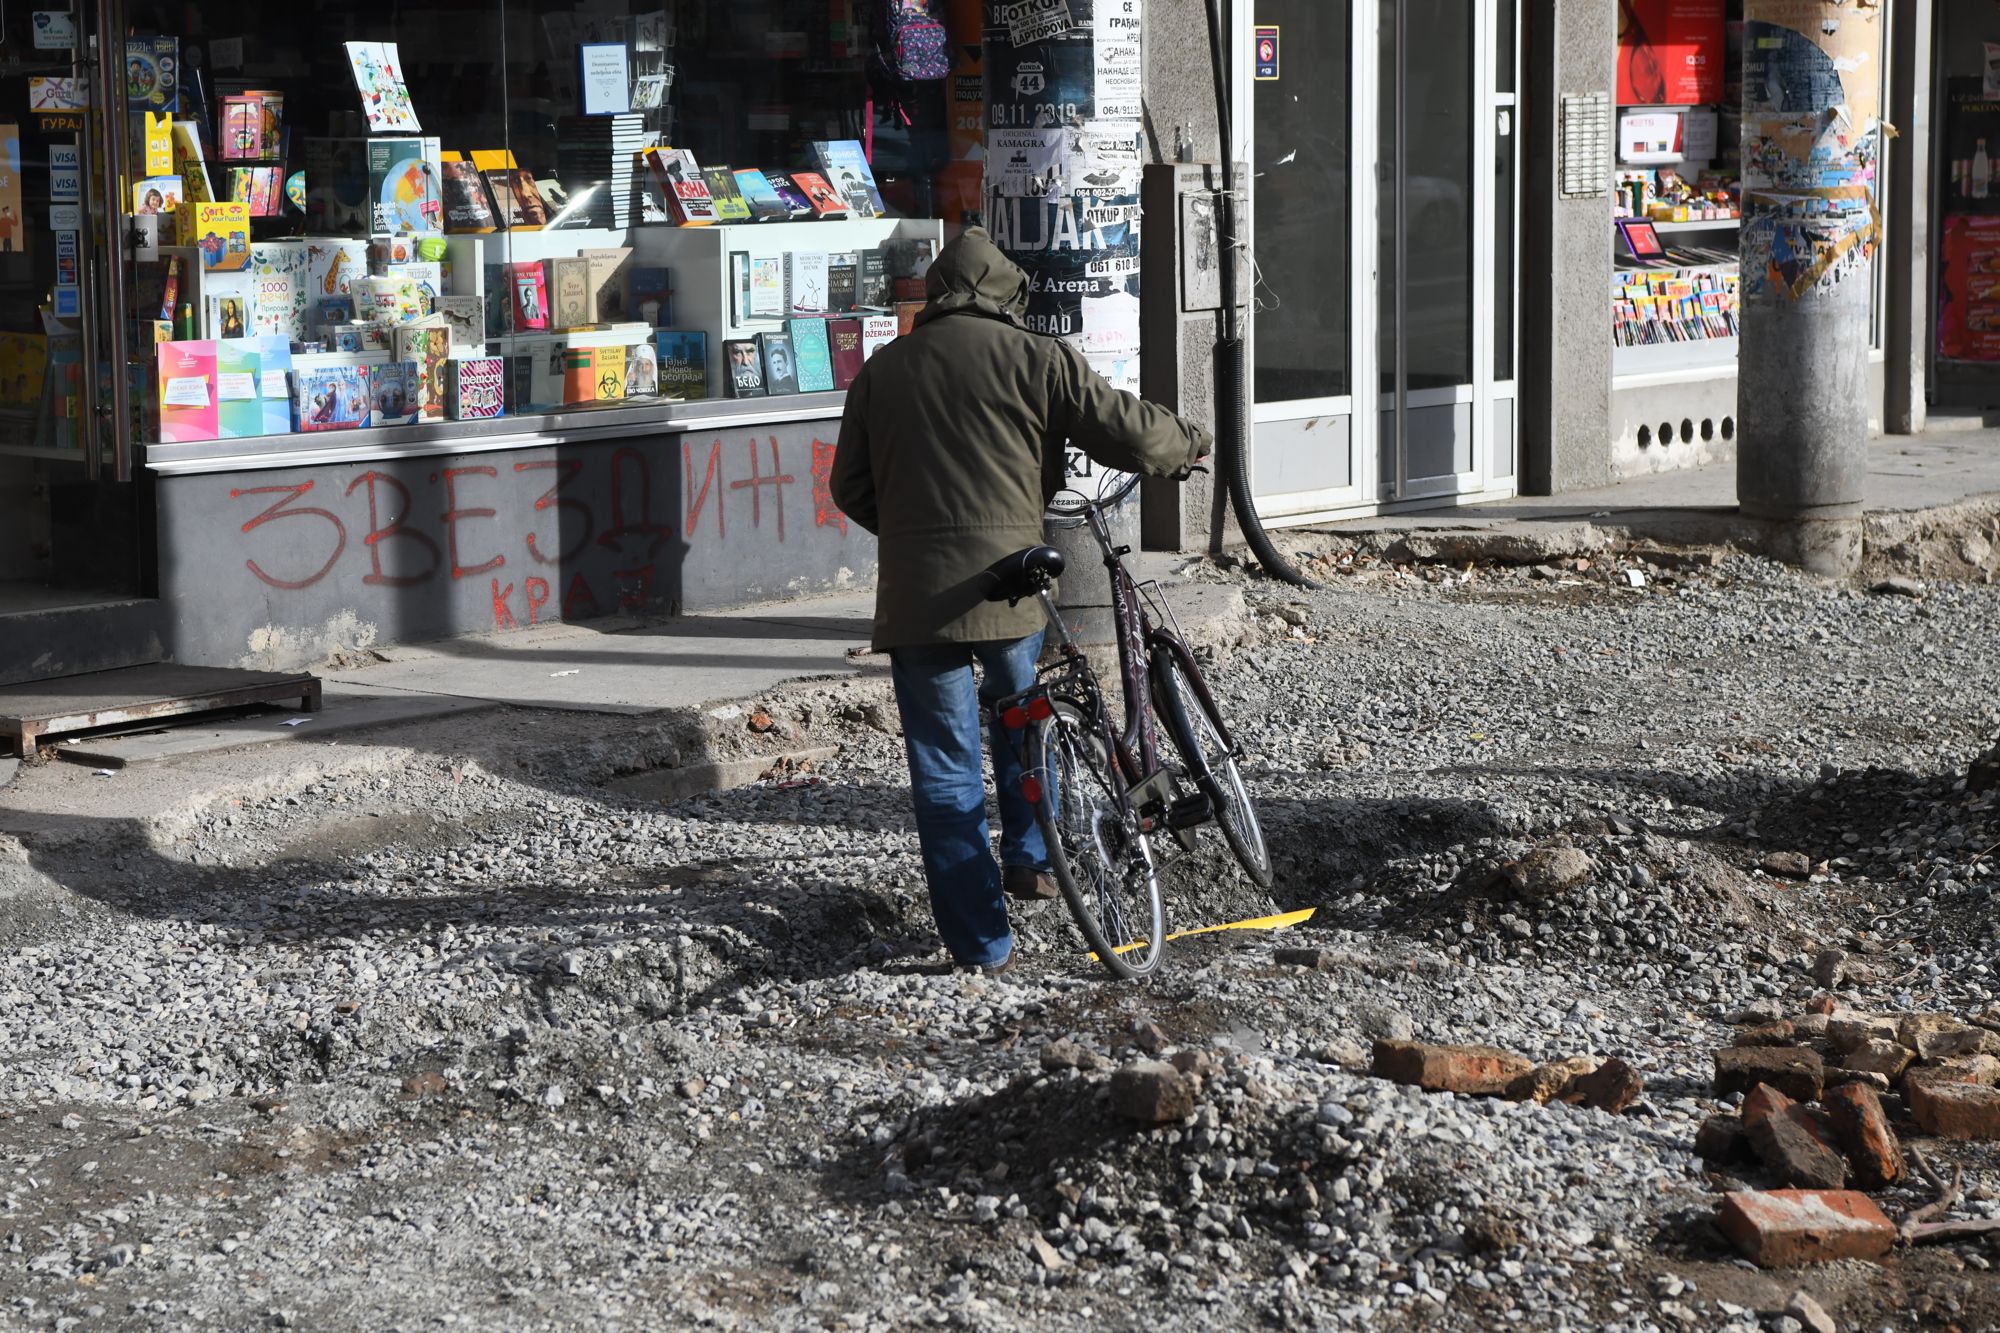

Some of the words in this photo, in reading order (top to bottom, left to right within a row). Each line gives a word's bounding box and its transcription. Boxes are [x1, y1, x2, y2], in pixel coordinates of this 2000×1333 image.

[1123, 2, 1132, 12] СЕ
[1013, 19, 1071, 45] LAPTOPOVA
[1020, 76, 1039, 90] 44
[41, 118, 83, 129] ГУРАЈ
[997, 140, 1046, 148] KAMAGRA
[54, 153, 77, 163] VISA
[55, 179, 78, 188] VISA
[201, 206, 224, 222] Sort
[1087, 208, 1119, 224] OTKUP
[261, 282, 288, 293] 1000
[1043, 277, 1100, 292] Arena
[869, 320, 893, 328] STIVEN
[865, 329, 896, 338] DŽERARD
[661, 355, 688, 368] Тајна
[461, 374, 502, 386] memory
